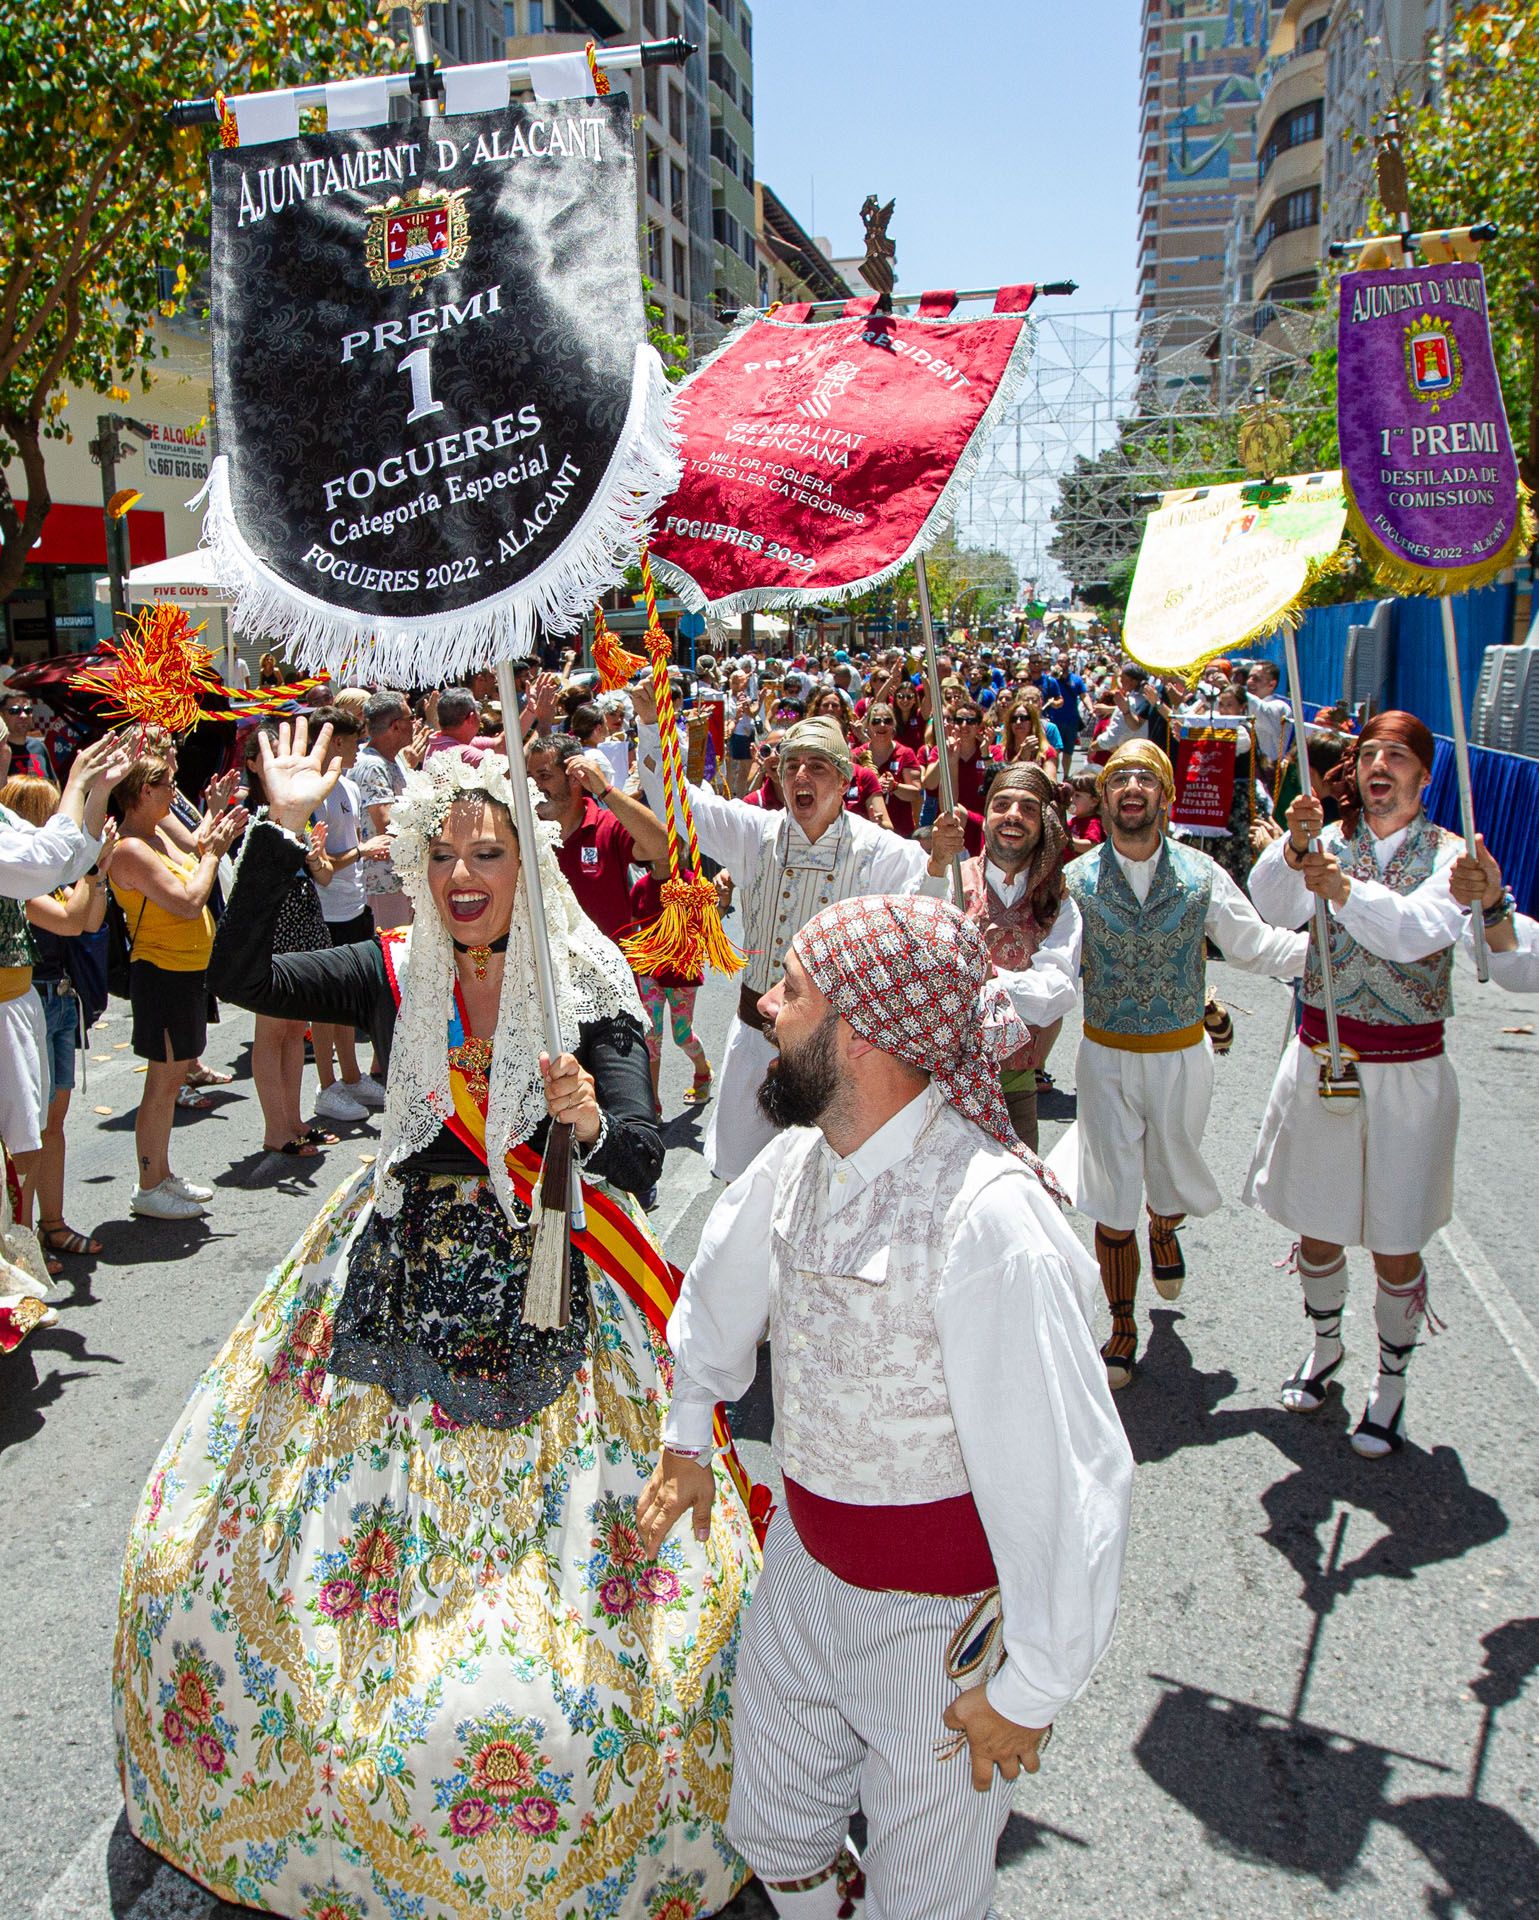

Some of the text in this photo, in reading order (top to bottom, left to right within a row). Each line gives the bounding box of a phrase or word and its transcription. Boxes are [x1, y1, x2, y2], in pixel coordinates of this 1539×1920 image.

[237, 143, 420, 228] AJUNTAMENT
[341, 284, 502, 364] PREMI
[842, 331, 972, 391] PRESIDENT
[397, 347, 444, 424] 1
[163, 426, 207, 447] ALQUILA
[322, 403, 543, 512] FOGUERES
[724, 430, 850, 470] VALENCIANA
[732, 422, 867, 450] GENERALITAT
[1411, 422, 1499, 456] PREMI
[157, 458, 209, 480] 667 673 663
[709, 451, 833, 497] MILLOR FOGUERA
[1380, 467, 1500, 486] DESFILADA DE
[329, 444, 550, 547] Categoría Especial
[691, 459, 736, 479] TOTES
[738, 470, 767, 487] LES
[768, 480, 866, 525] CATEGORIES
[1389, 489, 1495, 508] COMISSIONS
[301, 543, 420, 593] FOGUERES
[425, 556, 480, 590] 2022
[498, 454, 583, 565] ALACANT
[664, 515, 817, 573] FOGUERES 2022
[1374, 513, 1430, 558] FOGUERES
[1433, 547, 1462, 559] 2022
[1472, 518, 1507, 554] ALACANT
[153, 587, 208, 596] FIVE GUYS
[1183, 791, 1220, 800] FOGUERA
[1186, 783, 1219, 792] MILLOR
[1207, 809, 1224, 817] 2022
